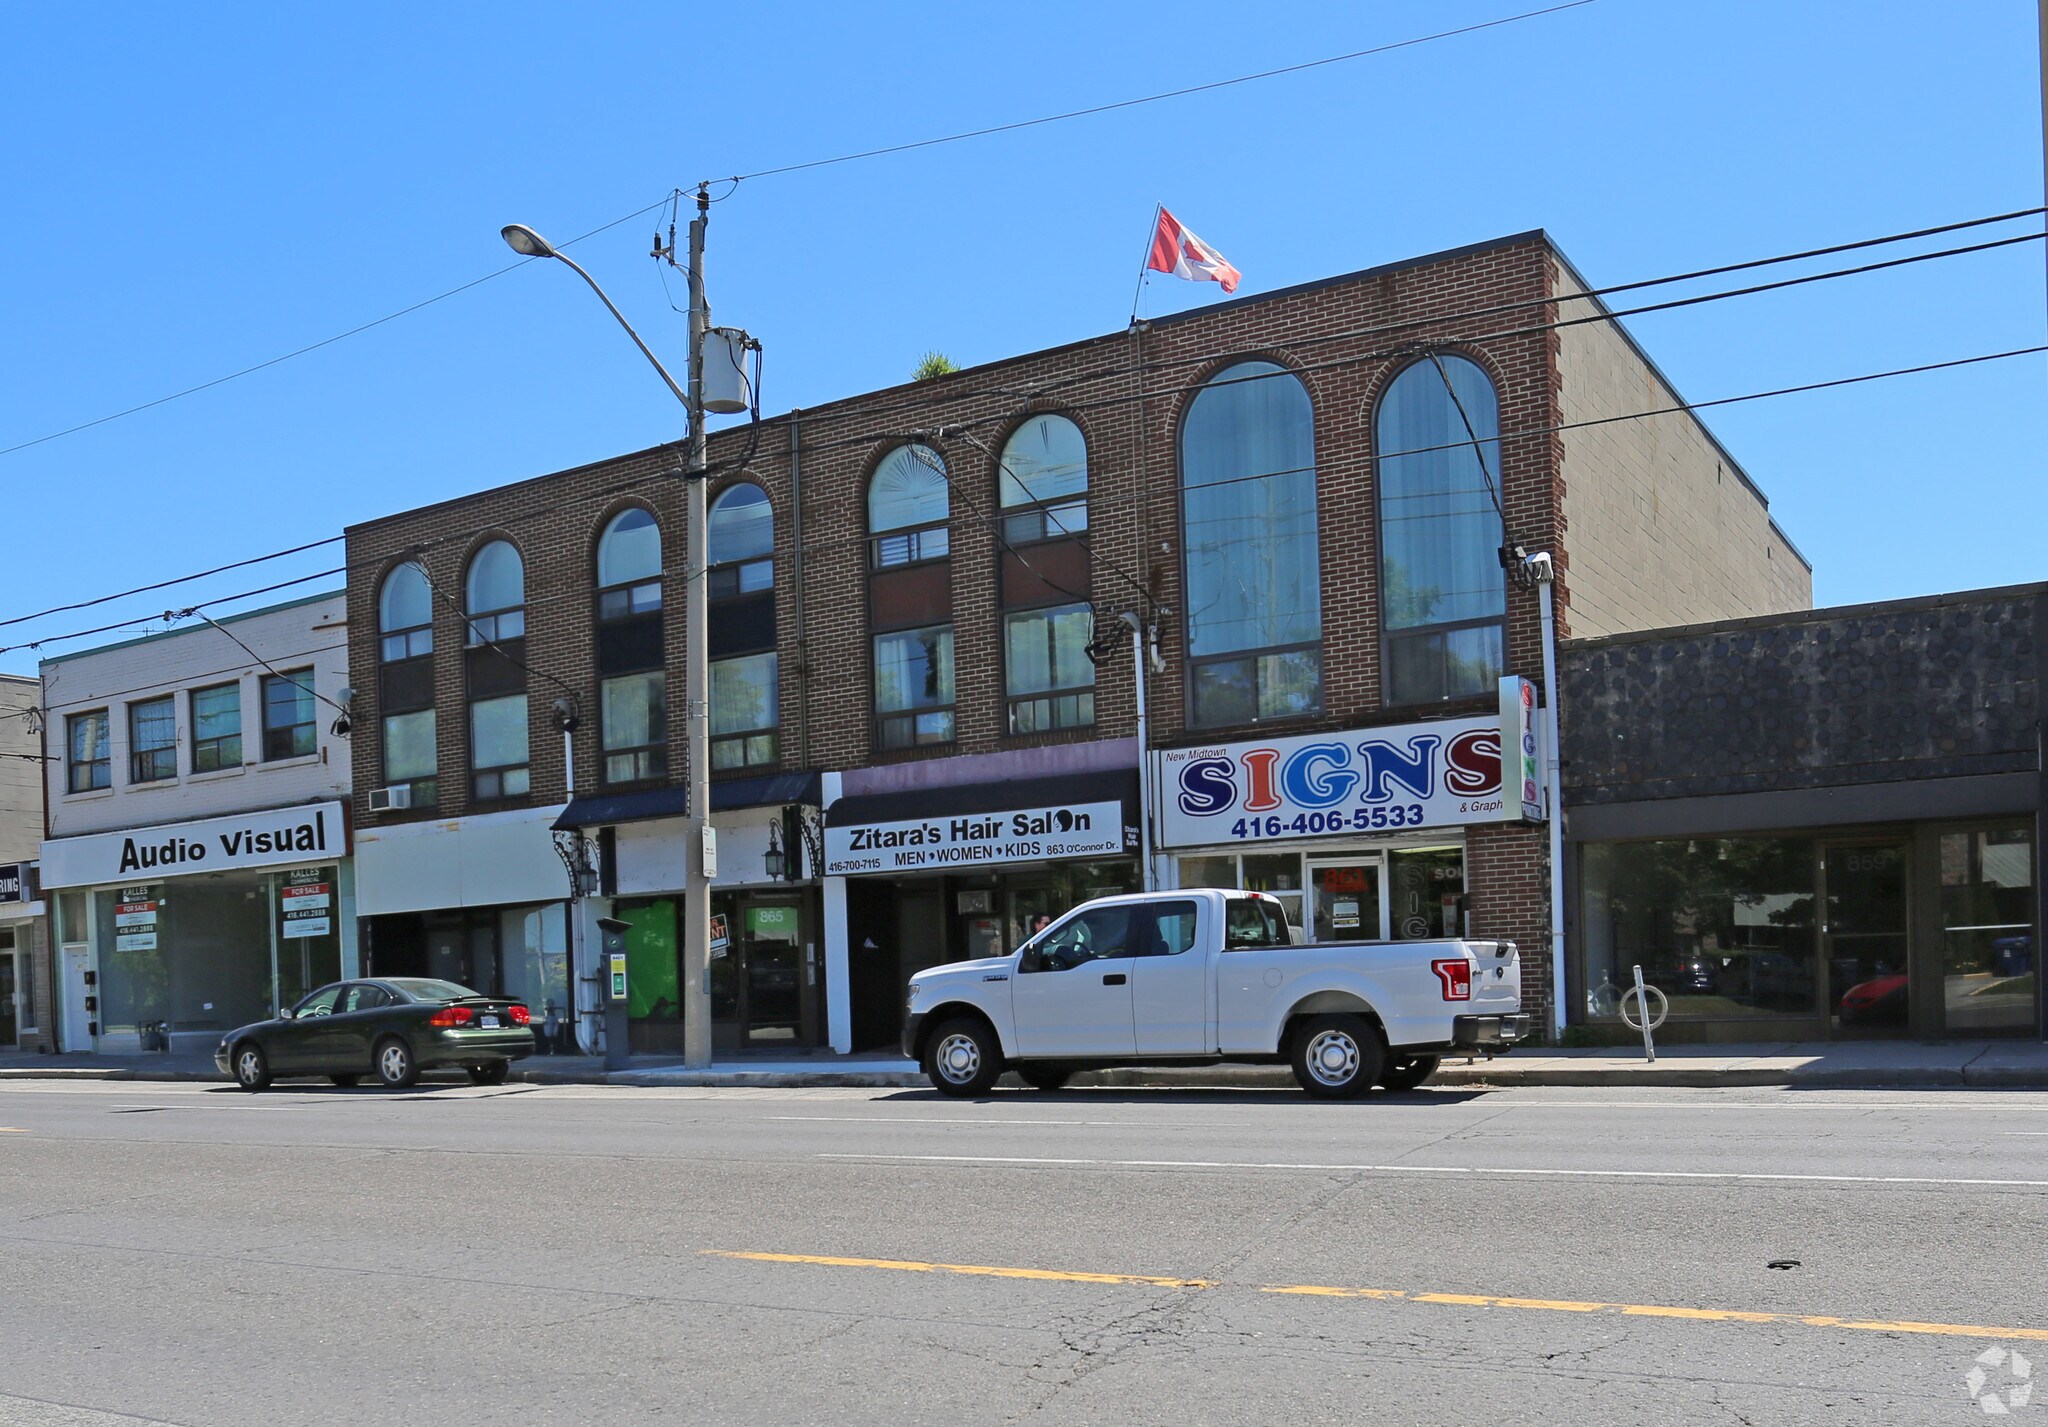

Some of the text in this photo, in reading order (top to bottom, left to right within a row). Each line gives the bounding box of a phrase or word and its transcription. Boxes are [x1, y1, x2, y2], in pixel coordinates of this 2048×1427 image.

[1521, 682, 1537, 803] SIGNS
[1165, 747, 1227, 763] New Midtown
[1178, 727, 1502, 817] SIGNS
[1459, 802, 1468, 813] &
[1231, 803, 1424, 839] 416-406-5533
[119, 810, 326, 874] Audio Visual
[849, 821, 942, 852] Zitara's
[950, 816, 1003, 842] Hair
[895, 841, 1041, 866] MEN WOMEN KIDS
[1046, 842, 1119, 855] 863 O'Connor Dr.
[828, 858, 881, 873] 416-700-7115
[1847, 855, 1887, 871] 859
[291, 886, 320, 896] FOR SALE
[123, 903, 148, 913] FOR SALE
[760, 910, 784, 923] 865
